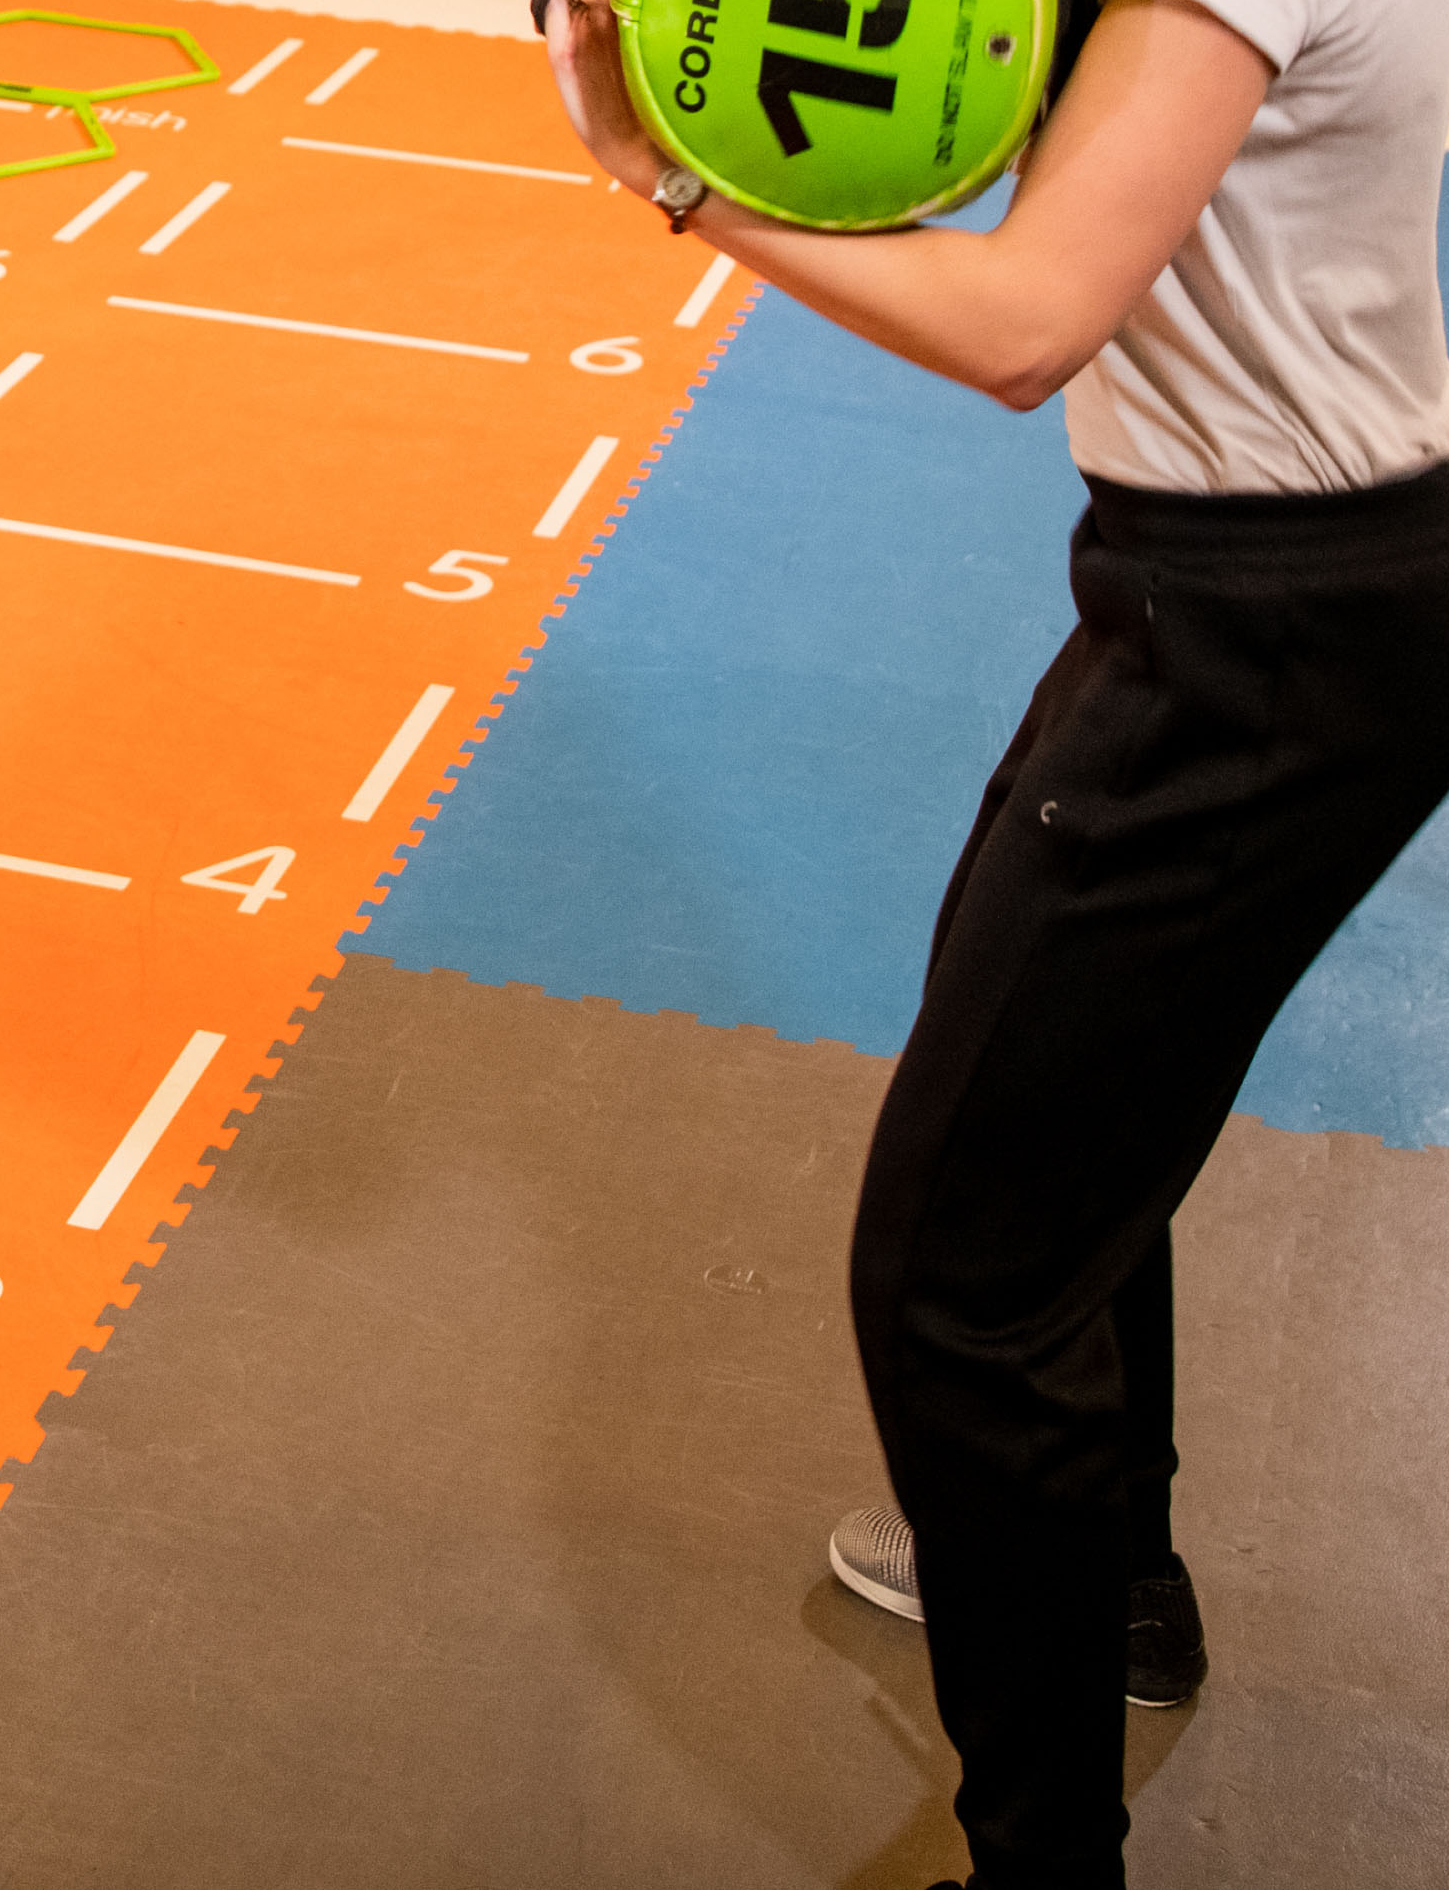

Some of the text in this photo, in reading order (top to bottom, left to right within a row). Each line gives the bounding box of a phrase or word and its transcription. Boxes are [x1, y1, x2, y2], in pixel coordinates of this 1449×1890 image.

[568, 335, 644, 375] 6
[402, 549, 510, 602] 5
[180, 845, 297, 916] 4
